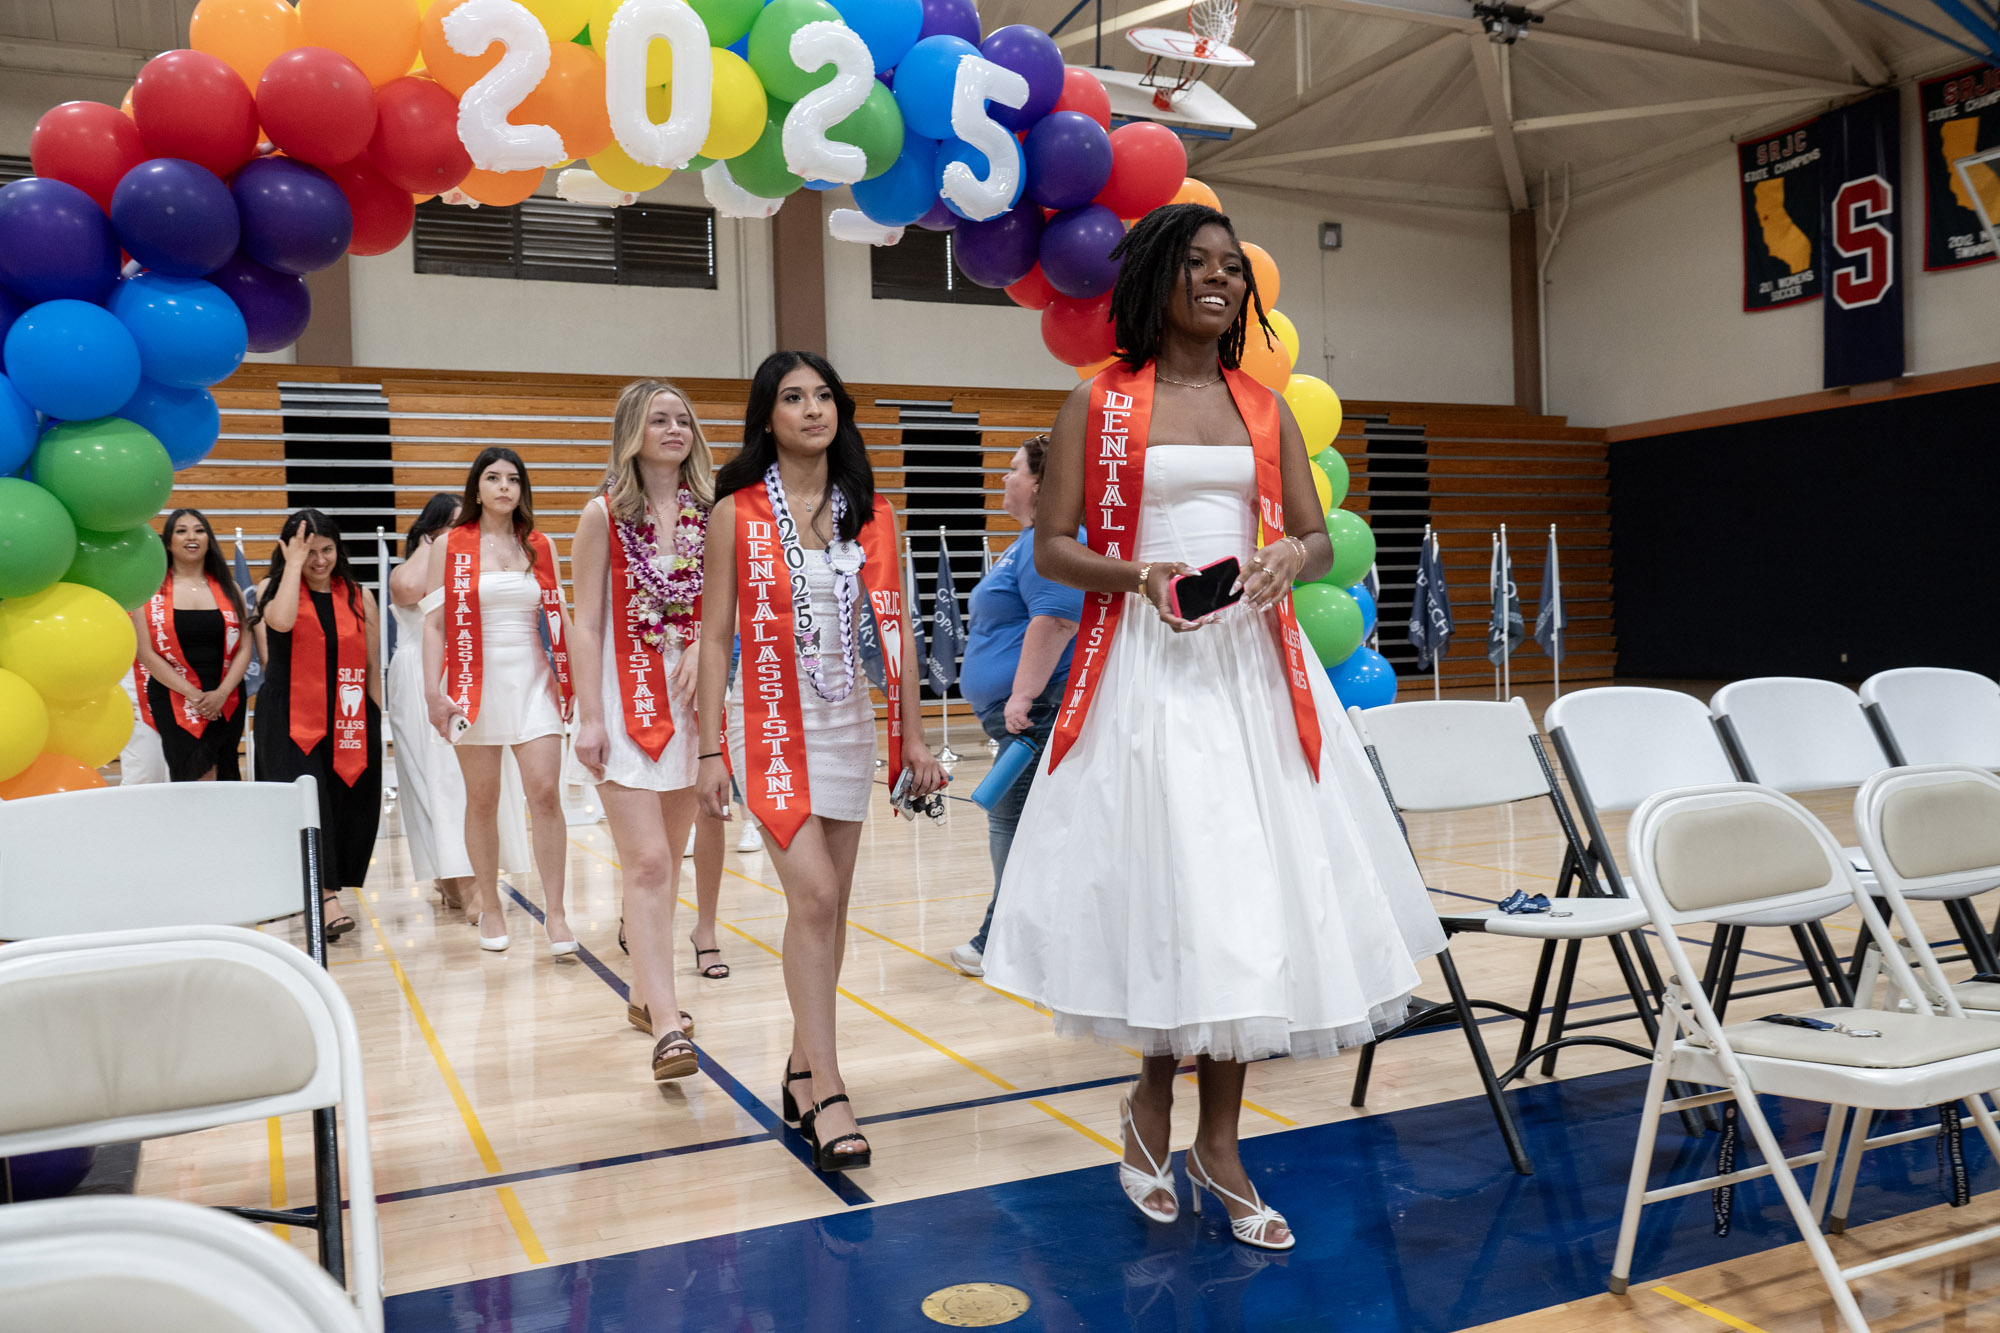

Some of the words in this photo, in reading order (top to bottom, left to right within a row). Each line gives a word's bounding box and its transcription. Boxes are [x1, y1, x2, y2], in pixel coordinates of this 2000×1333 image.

[443, 0, 1030, 222] 2025
[1743, 166, 1769, 183] STATE
[1756, 130, 1807, 166] SRJC
[1832, 174, 1893, 310] S
[1099, 390, 1133, 531] DENTAL
[1260, 495, 1284, 533] SRJC
[453, 553, 473, 626] DENTAL
[747, 521, 778, 642] DENTAL
[777, 516, 815, 632] 2025
[871, 590, 900, 616] SRJC
[150, 594, 172, 652] DENTAL
[1063, 542, 1121, 728] ASISTANT
[338, 668, 365, 682] SRJC
[456, 629, 474, 718] ASSISTAN
[335, 719, 365, 730] CLASS
[338, 739, 362, 749] 2025
[343, 730, 355, 739] OF
[755, 644, 795, 811] ASSISTANT
[1951, 1131, 1963, 1165] CAREER
